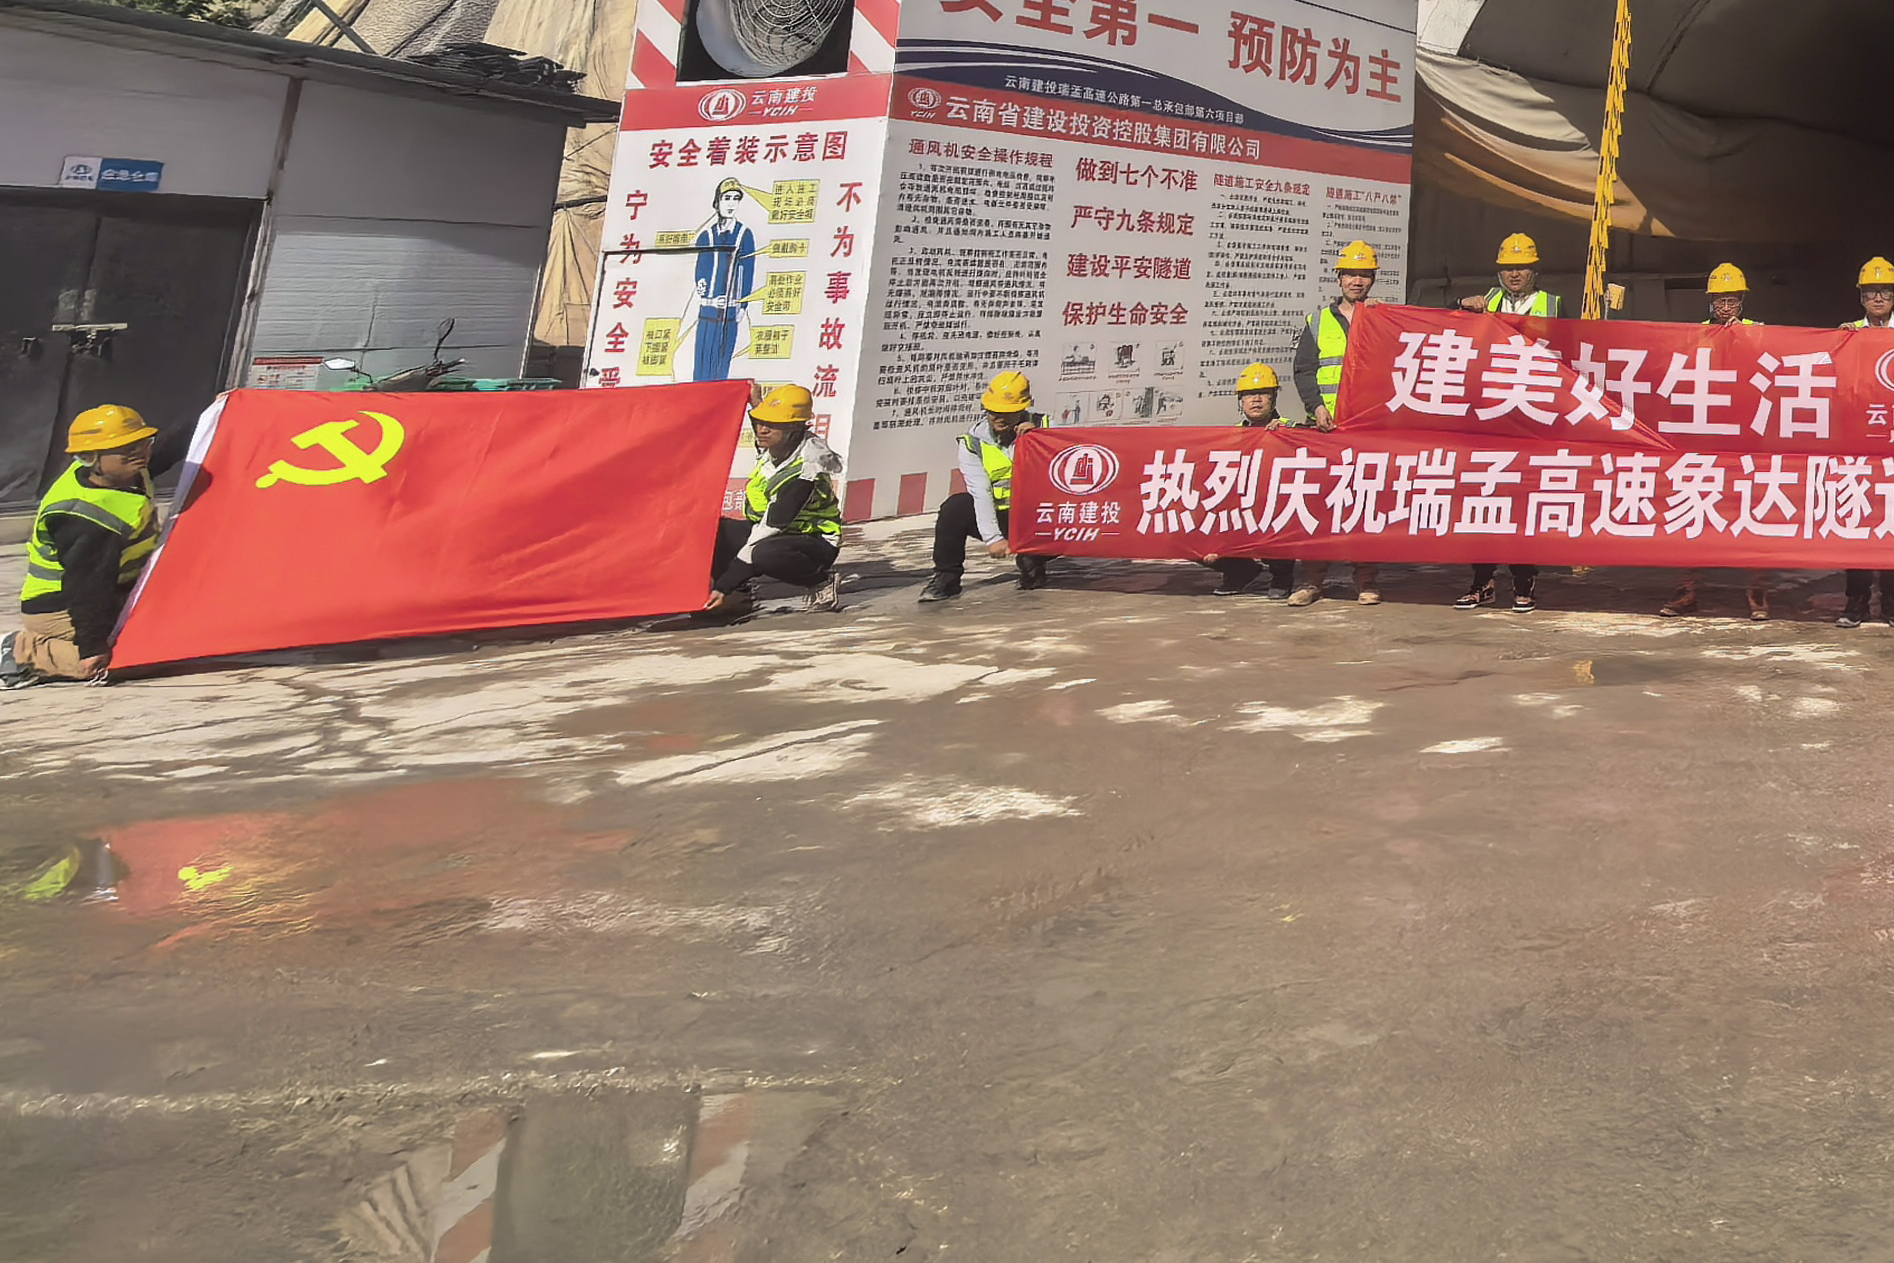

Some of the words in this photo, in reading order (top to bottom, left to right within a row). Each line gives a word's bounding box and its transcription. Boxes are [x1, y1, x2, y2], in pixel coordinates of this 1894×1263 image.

[1227, 10, 1403, 104] 预防为主
[751, 86, 818, 106] 云南建投
[946, 96, 1261, 159] 云南省建设投资控股集团有限公司
[649, 131, 848, 169] 安全着装示意图
[908, 138, 1054, 168] 通风机安全操作规程
[1075, 156, 1199, 191] 做到七个不准
[1213, 174, 1310, 196] 隧道施工安全九条规定
[1071, 204, 1195, 236] 严守九条规定
[1066, 253, 1192, 281] 建设平安隧道
[1062, 301, 1189, 327] 保护生命安全
[1386, 329, 1837, 439] 建美好生活
[1036, 501, 1120, 525] 云南建投
[1053, 527, 1098, 542] YCIH
